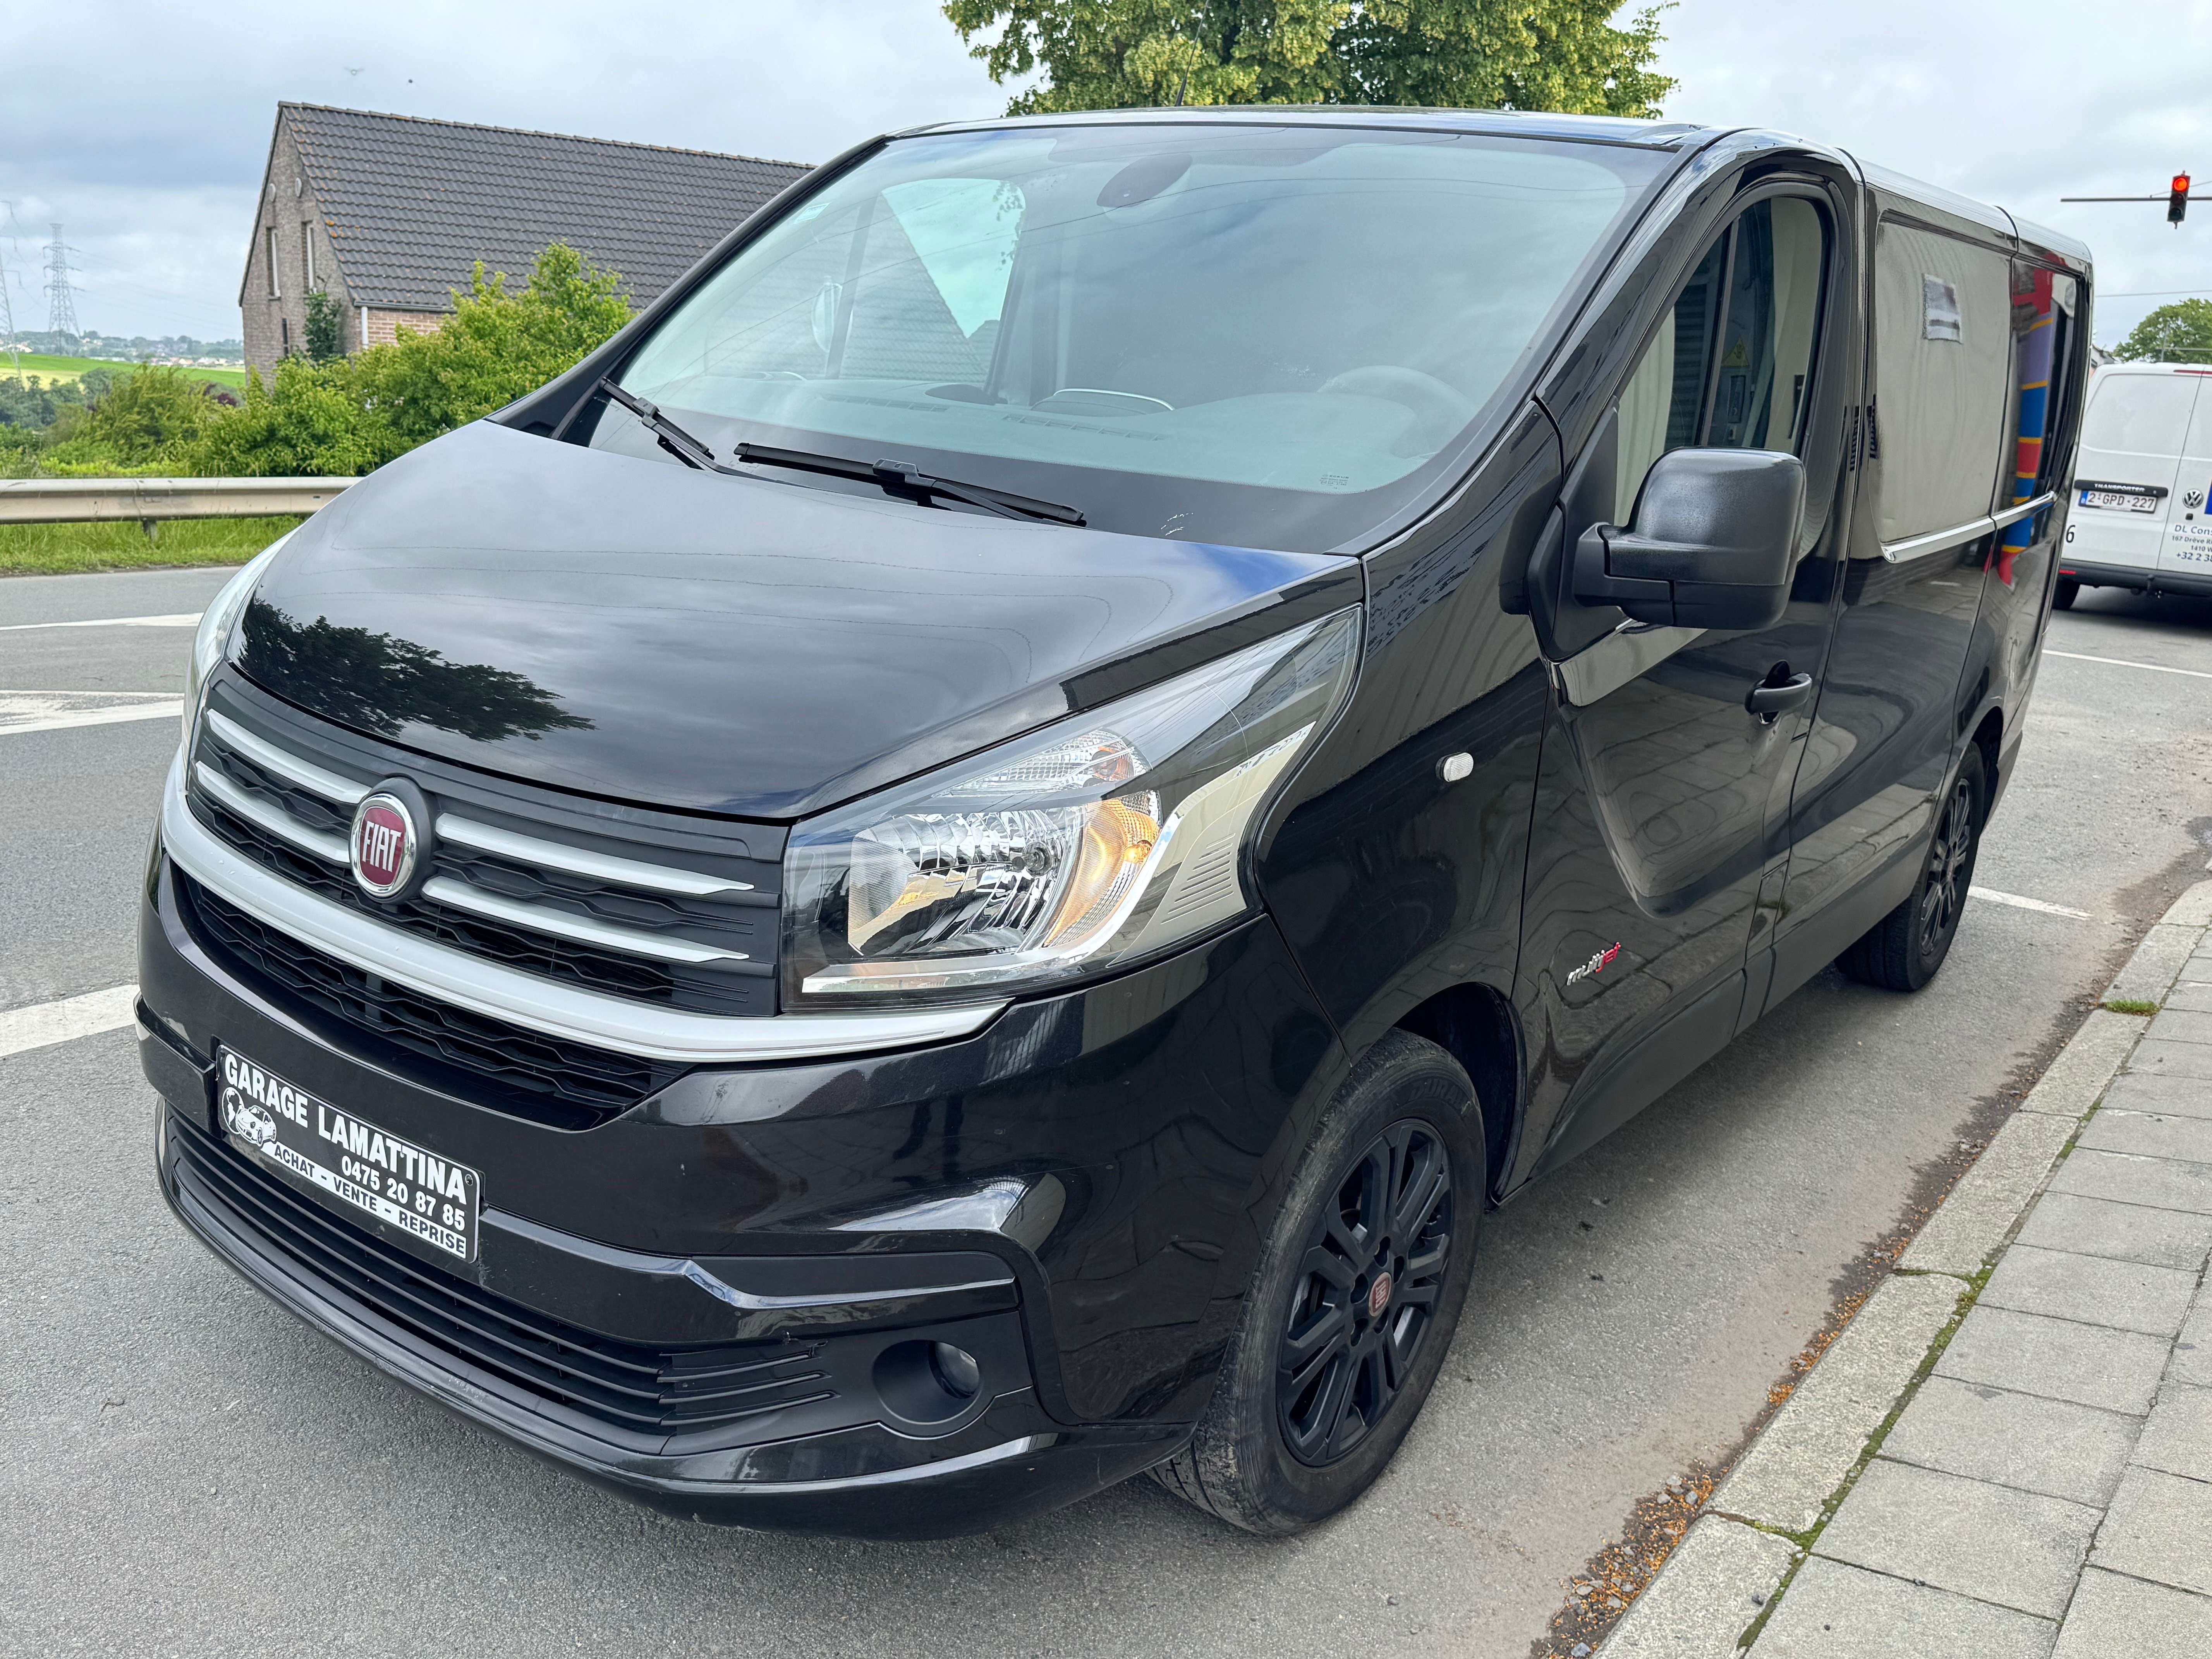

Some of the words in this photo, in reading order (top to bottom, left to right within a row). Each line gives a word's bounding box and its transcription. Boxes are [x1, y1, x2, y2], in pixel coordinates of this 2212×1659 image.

[2094, 483, 2145, 492] TRANSPORTER
[2066, 524, 2076, 543] 6
[2175, 525, 2187, 533] DL
[2176, 551, 2193, 560] +32
[362, 821, 402, 872] FIAT
[225, 1053, 308, 1128] GARAGE
[318, 1105, 467, 1205] LAMATTINA
[274, 1141, 315, 1177] ACHAT
[333, 1176, 377, 1210] VENTE
[398, 1209, 465, 1255] REPRISE
[341, 1155, 381, 1190] 0475
[387, 1180, 409, 1204] 20
[415, 1194, 436, 1216] 87
[442, 1209, 465, 1231] 85
[1375, 1281, 1387, 1309] FIAT
